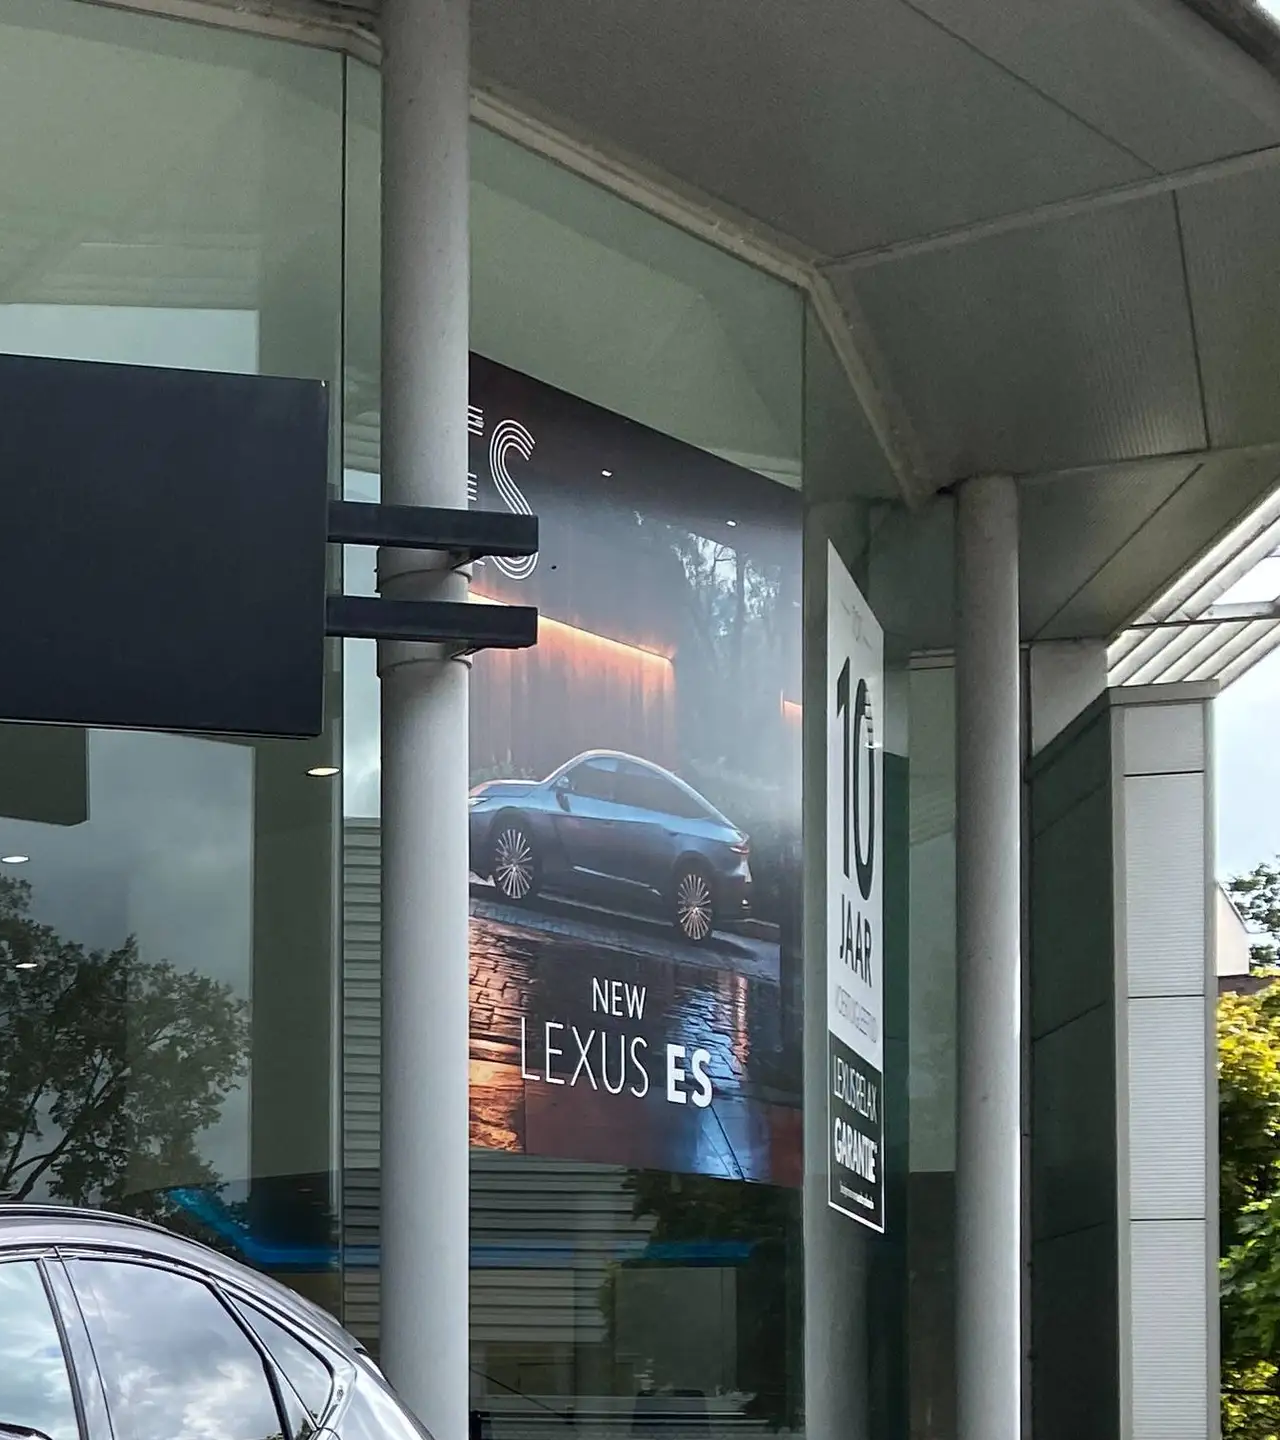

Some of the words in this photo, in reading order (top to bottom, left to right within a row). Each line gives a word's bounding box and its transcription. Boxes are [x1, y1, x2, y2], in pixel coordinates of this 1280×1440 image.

[837, 656, 875, 901] 10
[840, 894, 873, 988] JAAR
[593, 977, 647, 1020] NEW
[521, 1016, 649, 1098] LEXUS
[666, 1043, 713, 1108] ES
